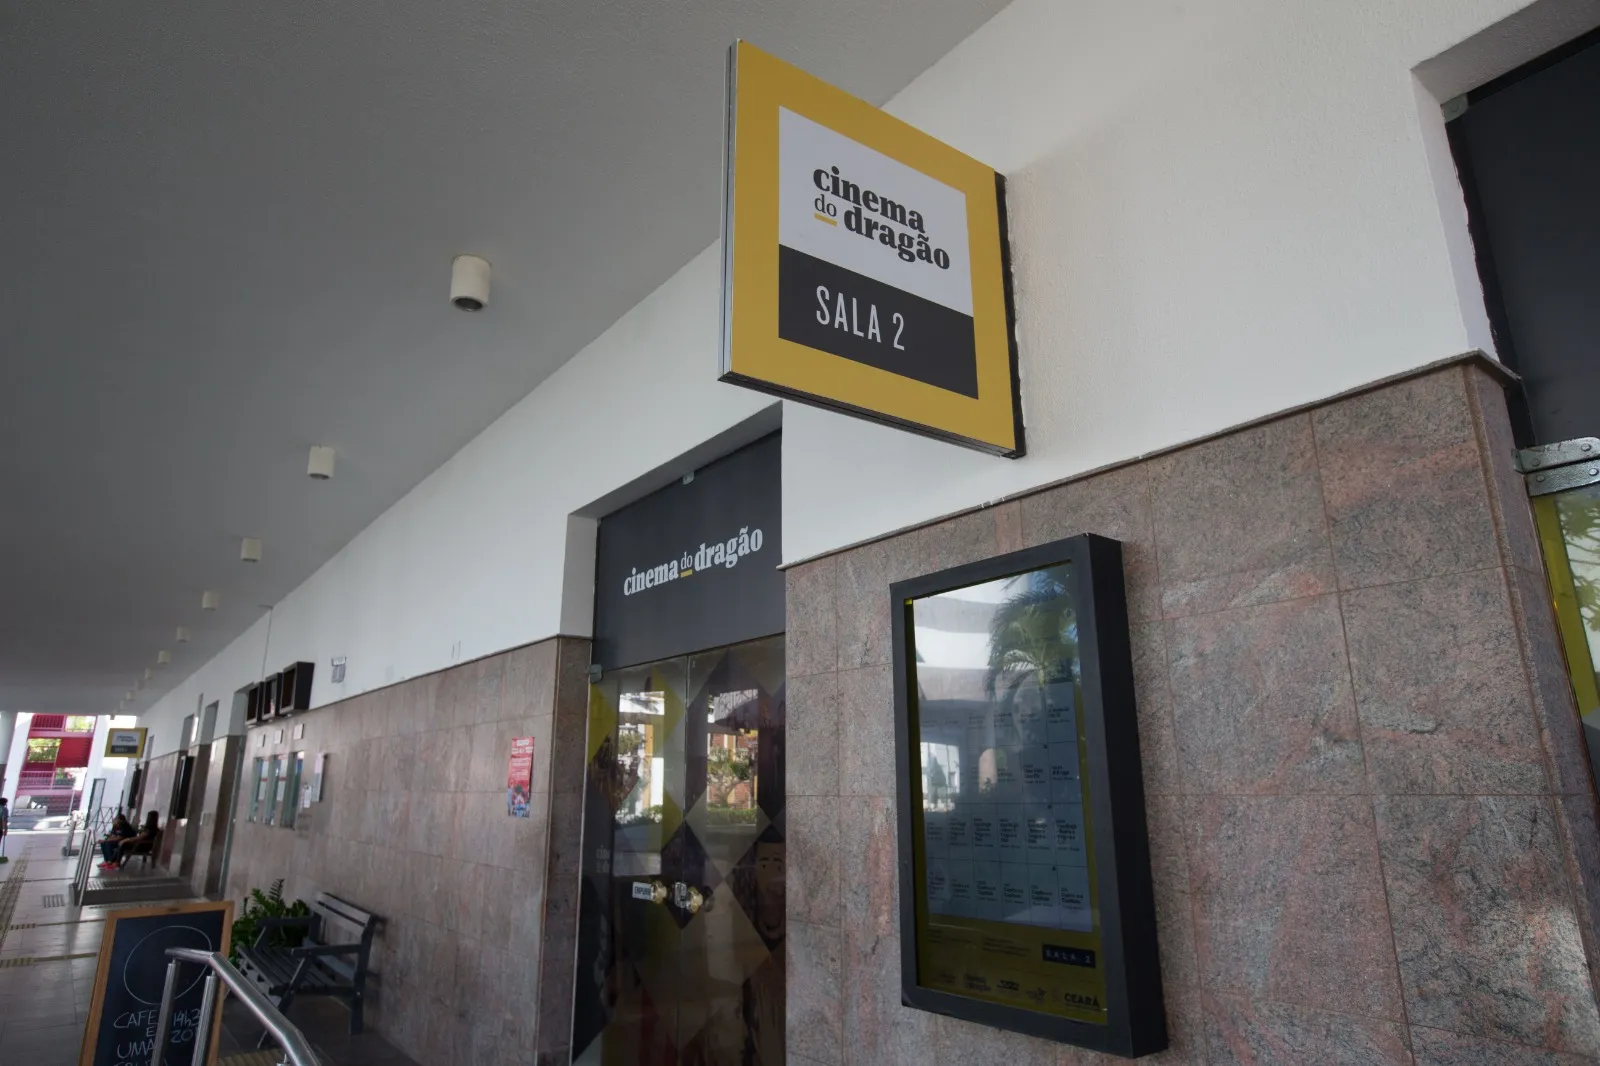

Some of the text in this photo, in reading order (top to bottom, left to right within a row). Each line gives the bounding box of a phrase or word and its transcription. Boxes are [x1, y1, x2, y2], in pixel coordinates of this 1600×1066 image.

[813, 166, 925, 233] cinema
[814, 193, 950, 270] do dragão
[816, 285, 905, 351] SALA 2
[623, 526, 763, 596] cinema do dragão
